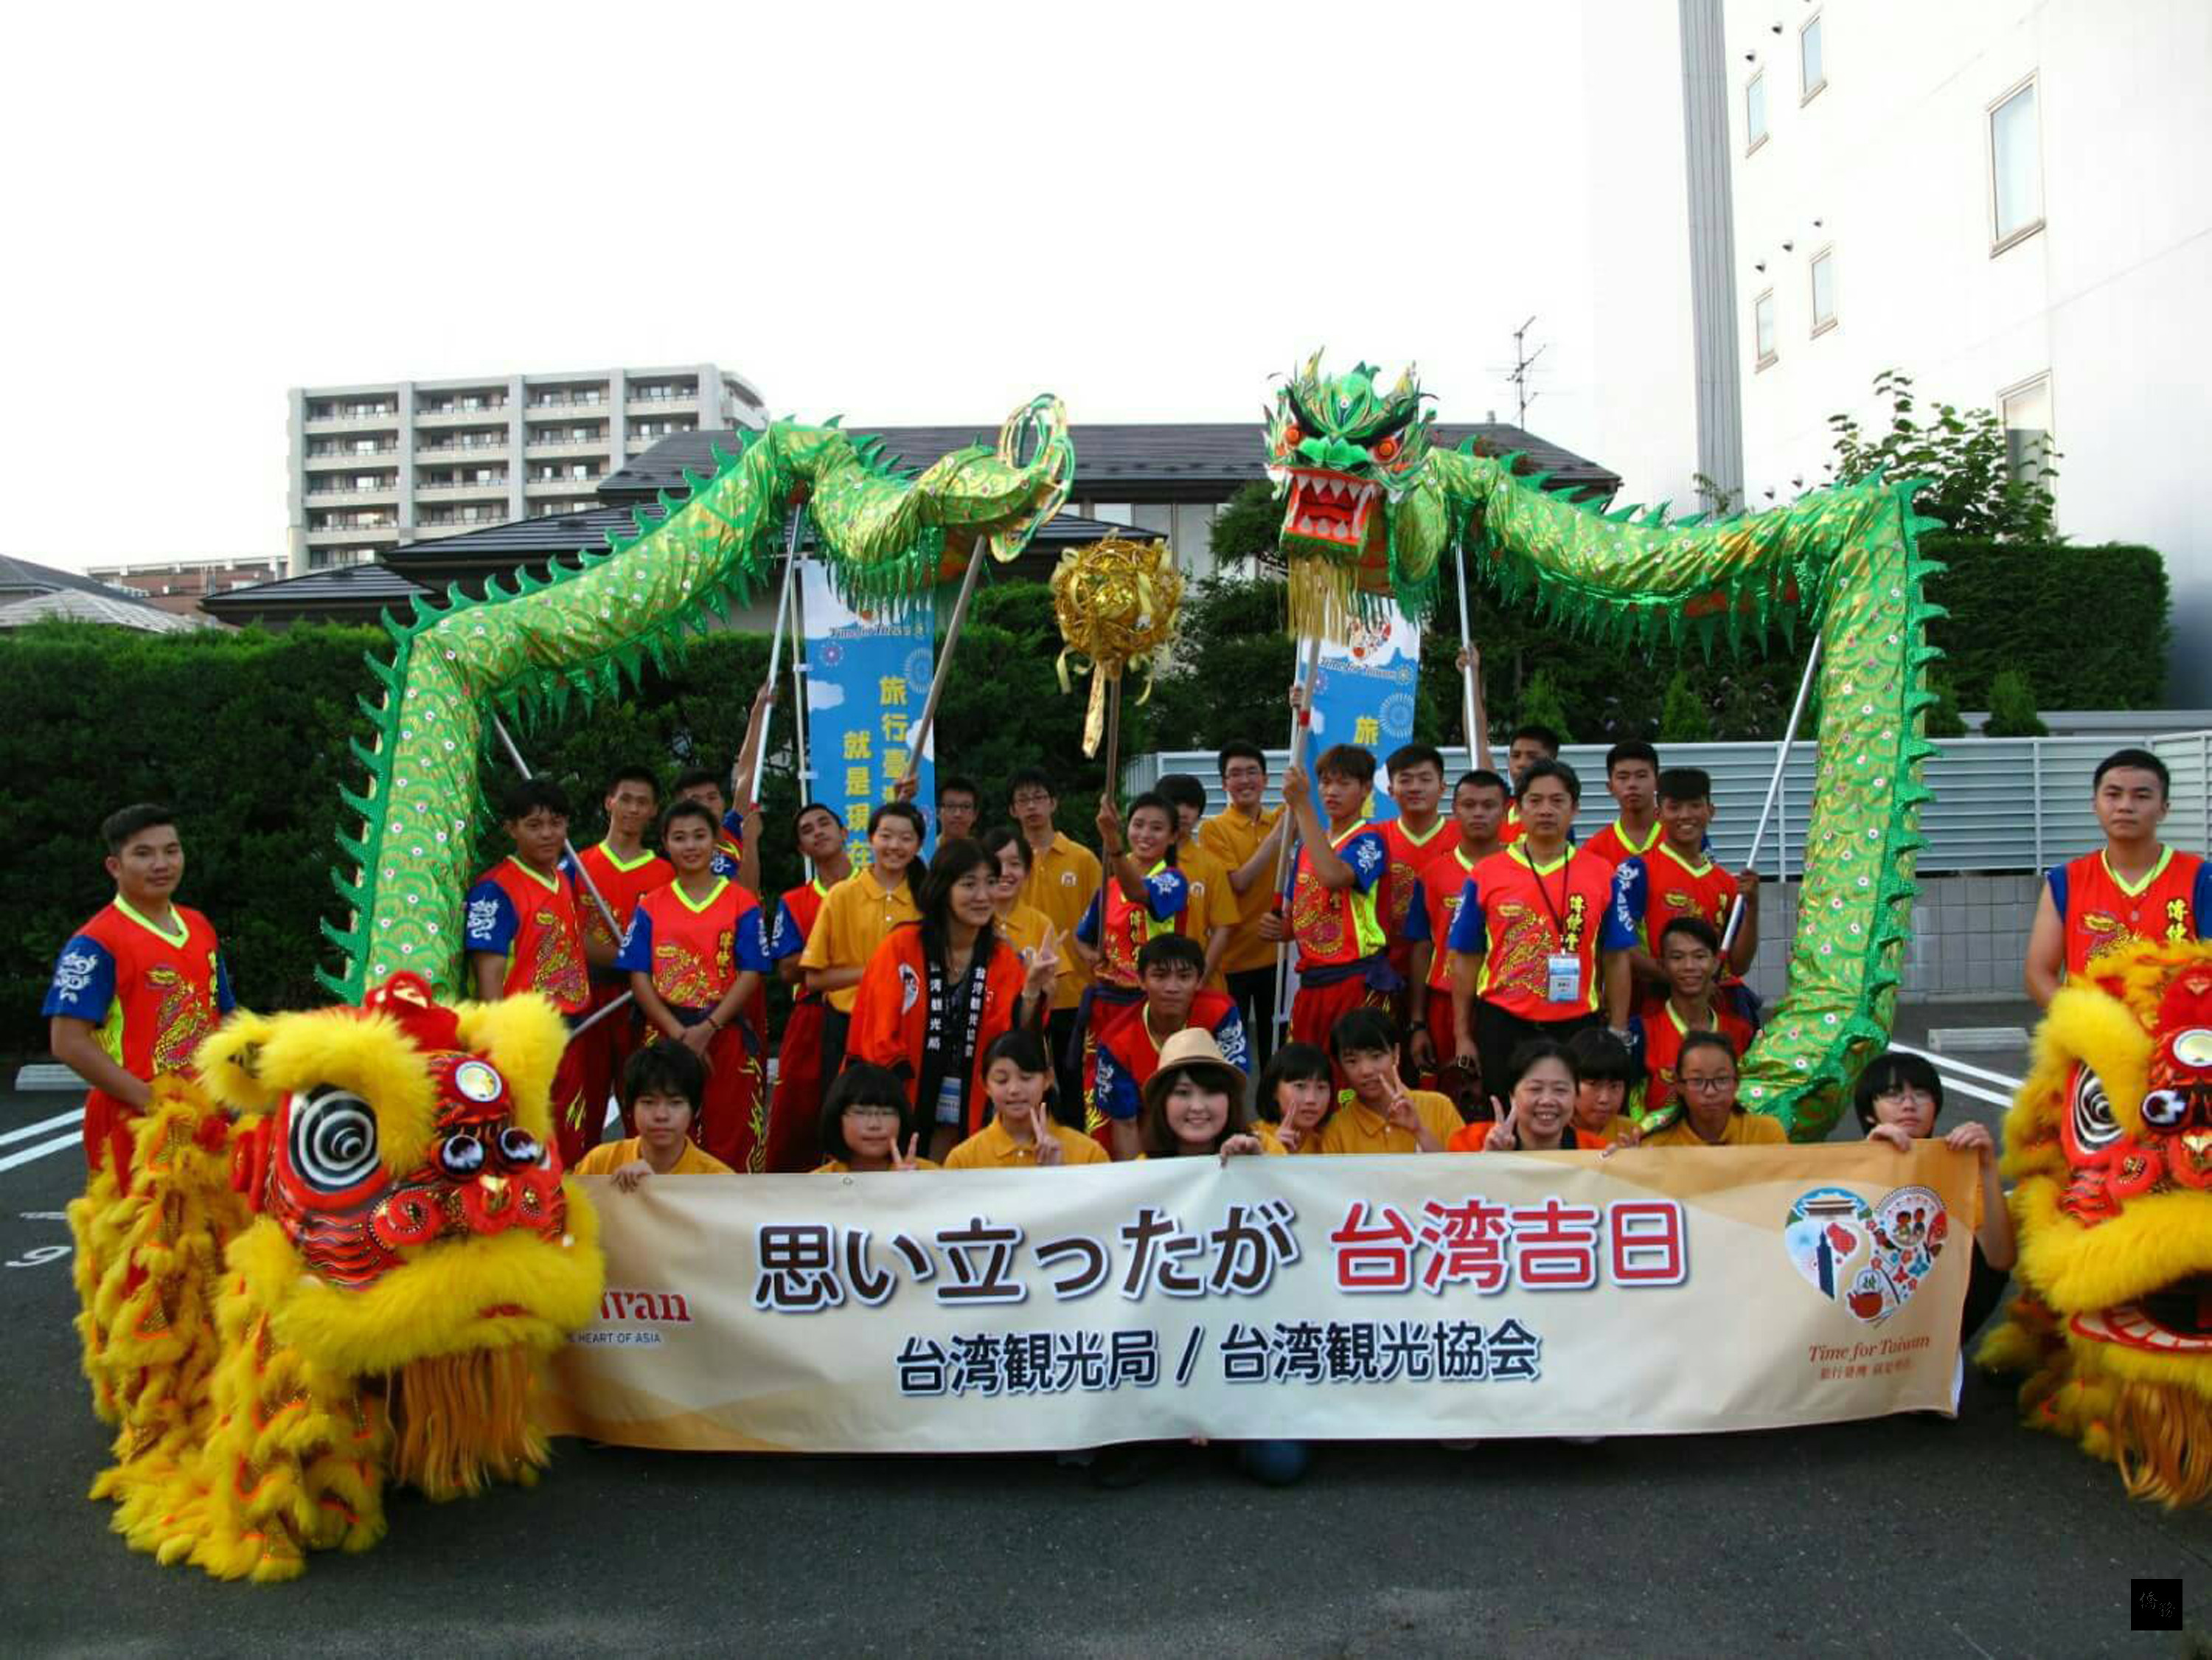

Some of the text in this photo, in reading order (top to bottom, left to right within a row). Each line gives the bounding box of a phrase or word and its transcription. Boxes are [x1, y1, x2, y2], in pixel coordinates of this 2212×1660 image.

[754, 1196, 1686, 1311] 思い立ったが 台湾吉日
[578, 1333, 613, 1344] HEART
[616, 1333, 632, 1344] OF
[635, 1333, 661, 1344] ASIA
[896, 1329, 1159, 1398] 台湾観光局
[1220, 1319, 1540, 1383] 台湾観光協会
[1809, 1336, 1930, 1363] Time for Taiwan
